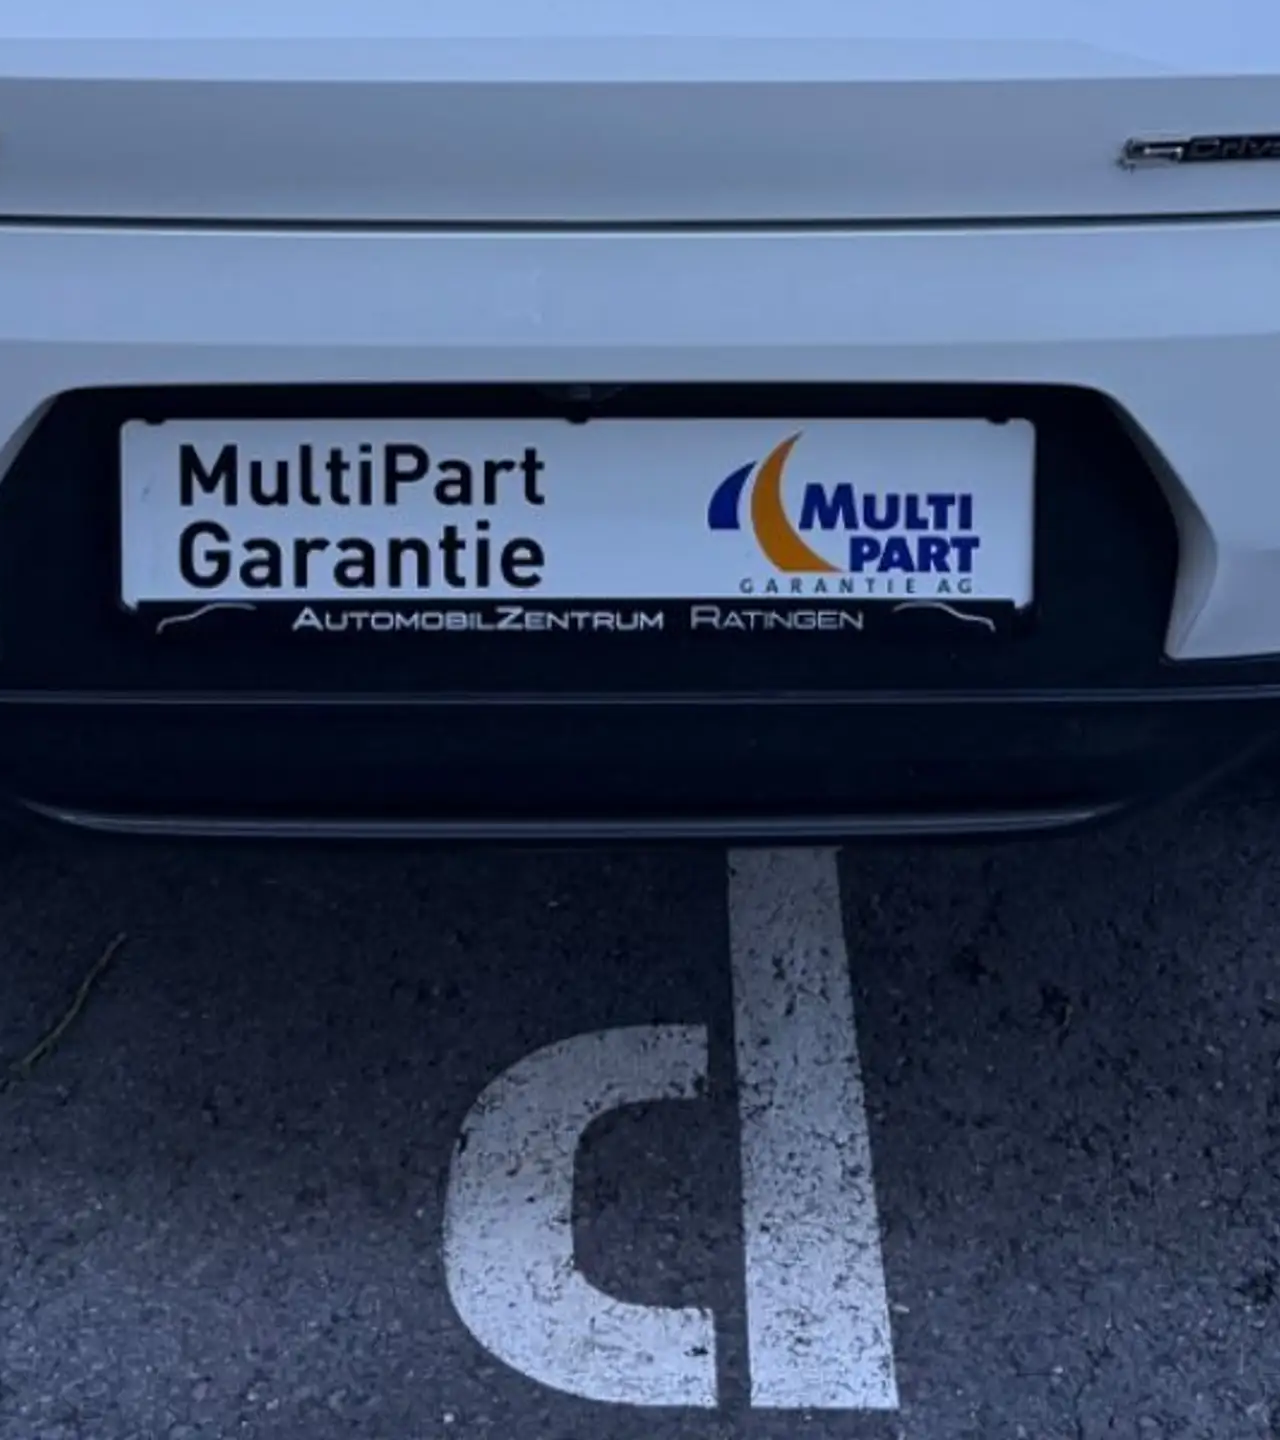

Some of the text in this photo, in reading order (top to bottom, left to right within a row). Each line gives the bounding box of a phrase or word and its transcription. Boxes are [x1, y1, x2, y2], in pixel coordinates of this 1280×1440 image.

[177, 441, 546, 507] MultiPart
[177, 519, 546, 590] Garantie
[848, 536, 980, 574] PART
[738, 577, 974, 595] GARANTIE AG
